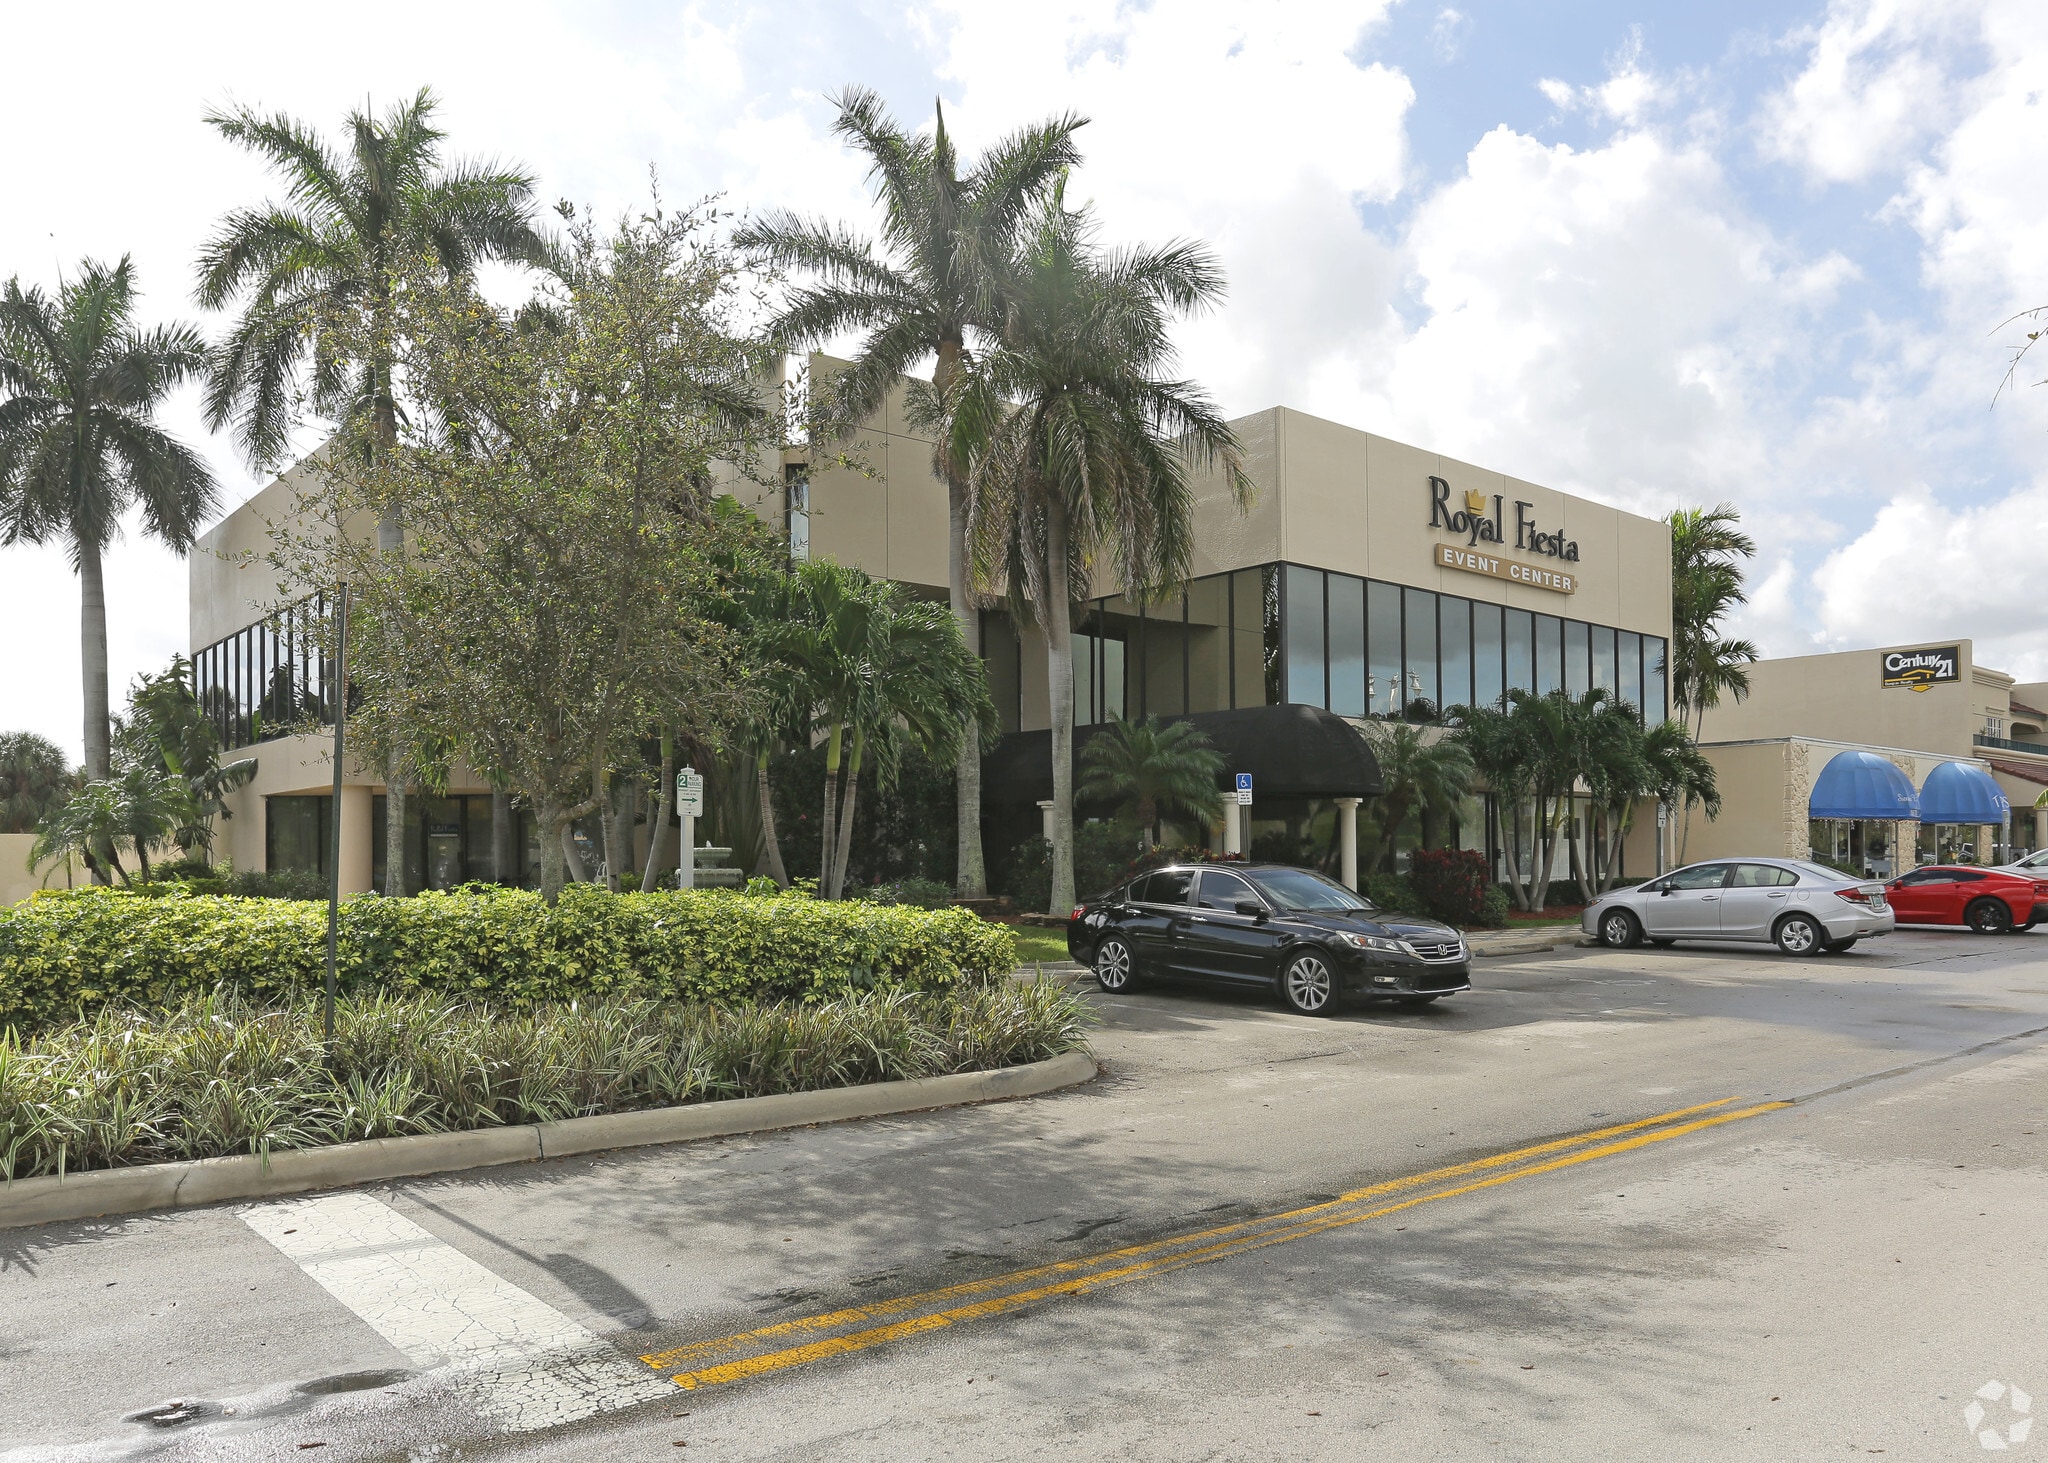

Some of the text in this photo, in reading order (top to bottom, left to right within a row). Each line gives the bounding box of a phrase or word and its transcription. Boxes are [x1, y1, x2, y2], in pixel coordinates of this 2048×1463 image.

[1428, 475, 1580, 562] Royal Fiesta
[1443, 548, 1572, 591] EVENT CENTER
[1885, 653, 1941, 672] Century
[1935, 659, 1953, 678] 21
[679, 775, 686, 786] 2
